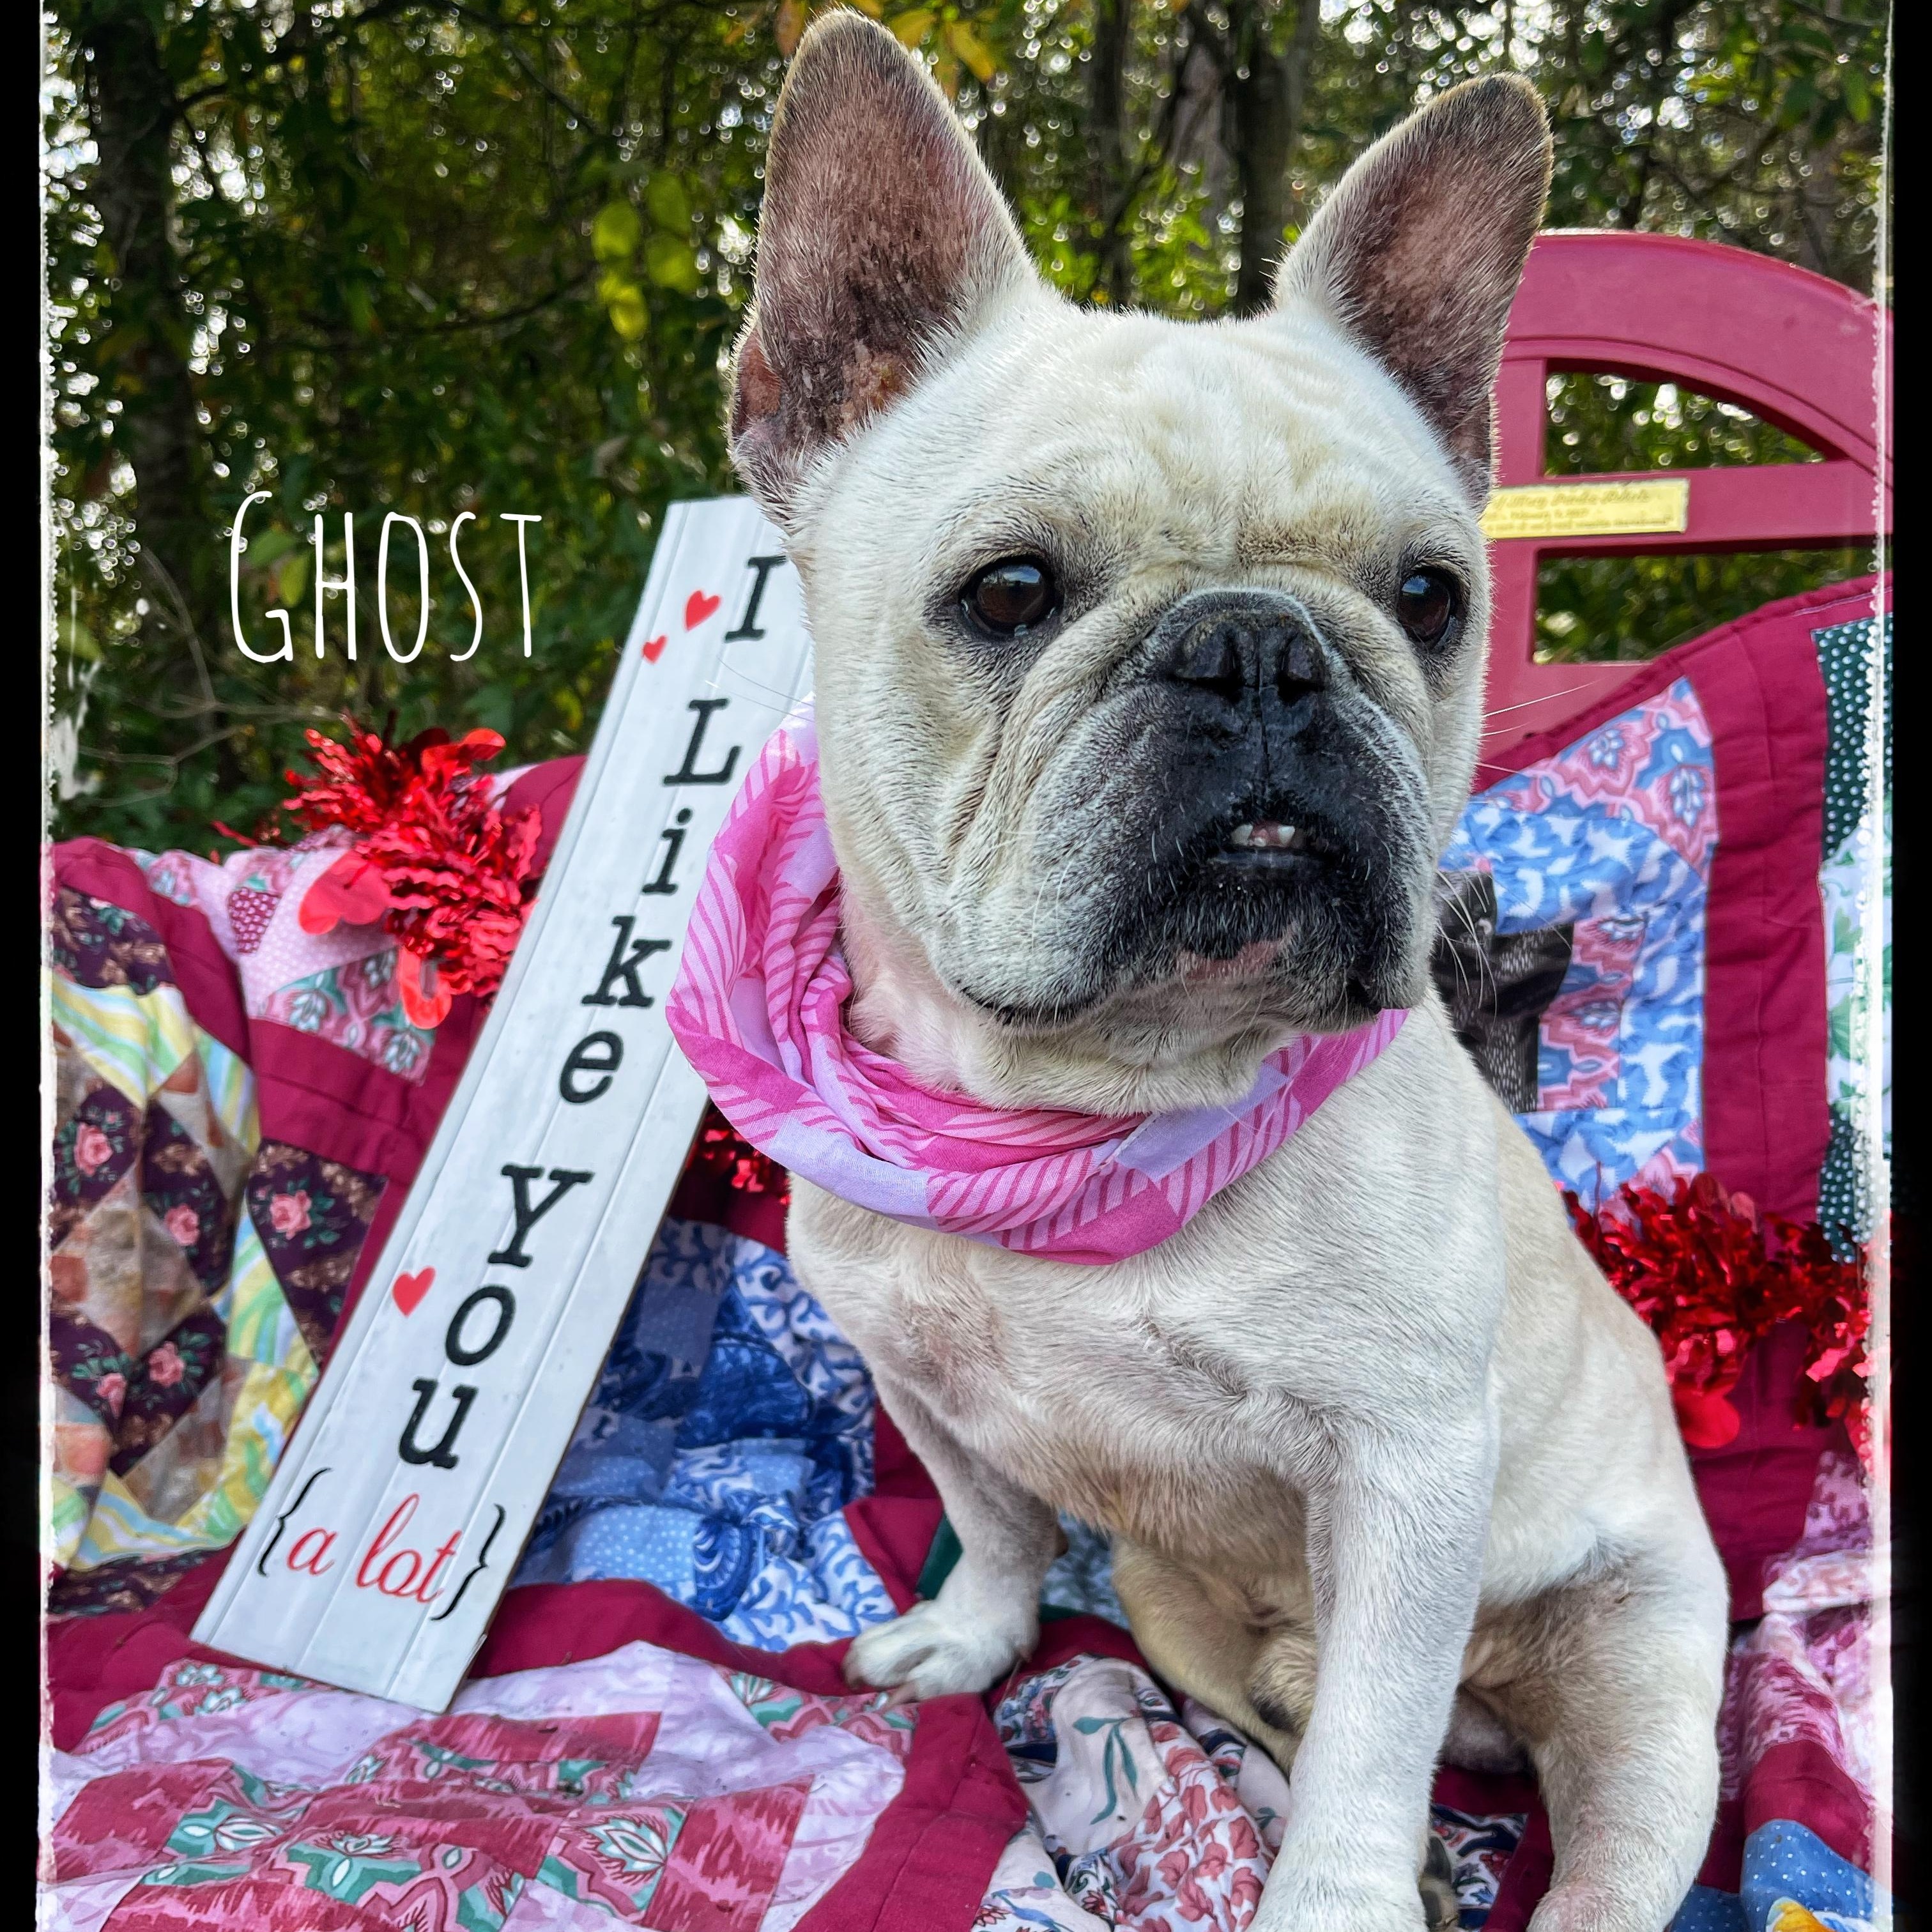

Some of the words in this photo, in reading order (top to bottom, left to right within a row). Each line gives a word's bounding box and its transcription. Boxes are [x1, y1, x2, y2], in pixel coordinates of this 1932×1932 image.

[724, 555, 787, 642] I
[560, 697, 742, 1105] Like
[398, 1164, 594, 1470] You
